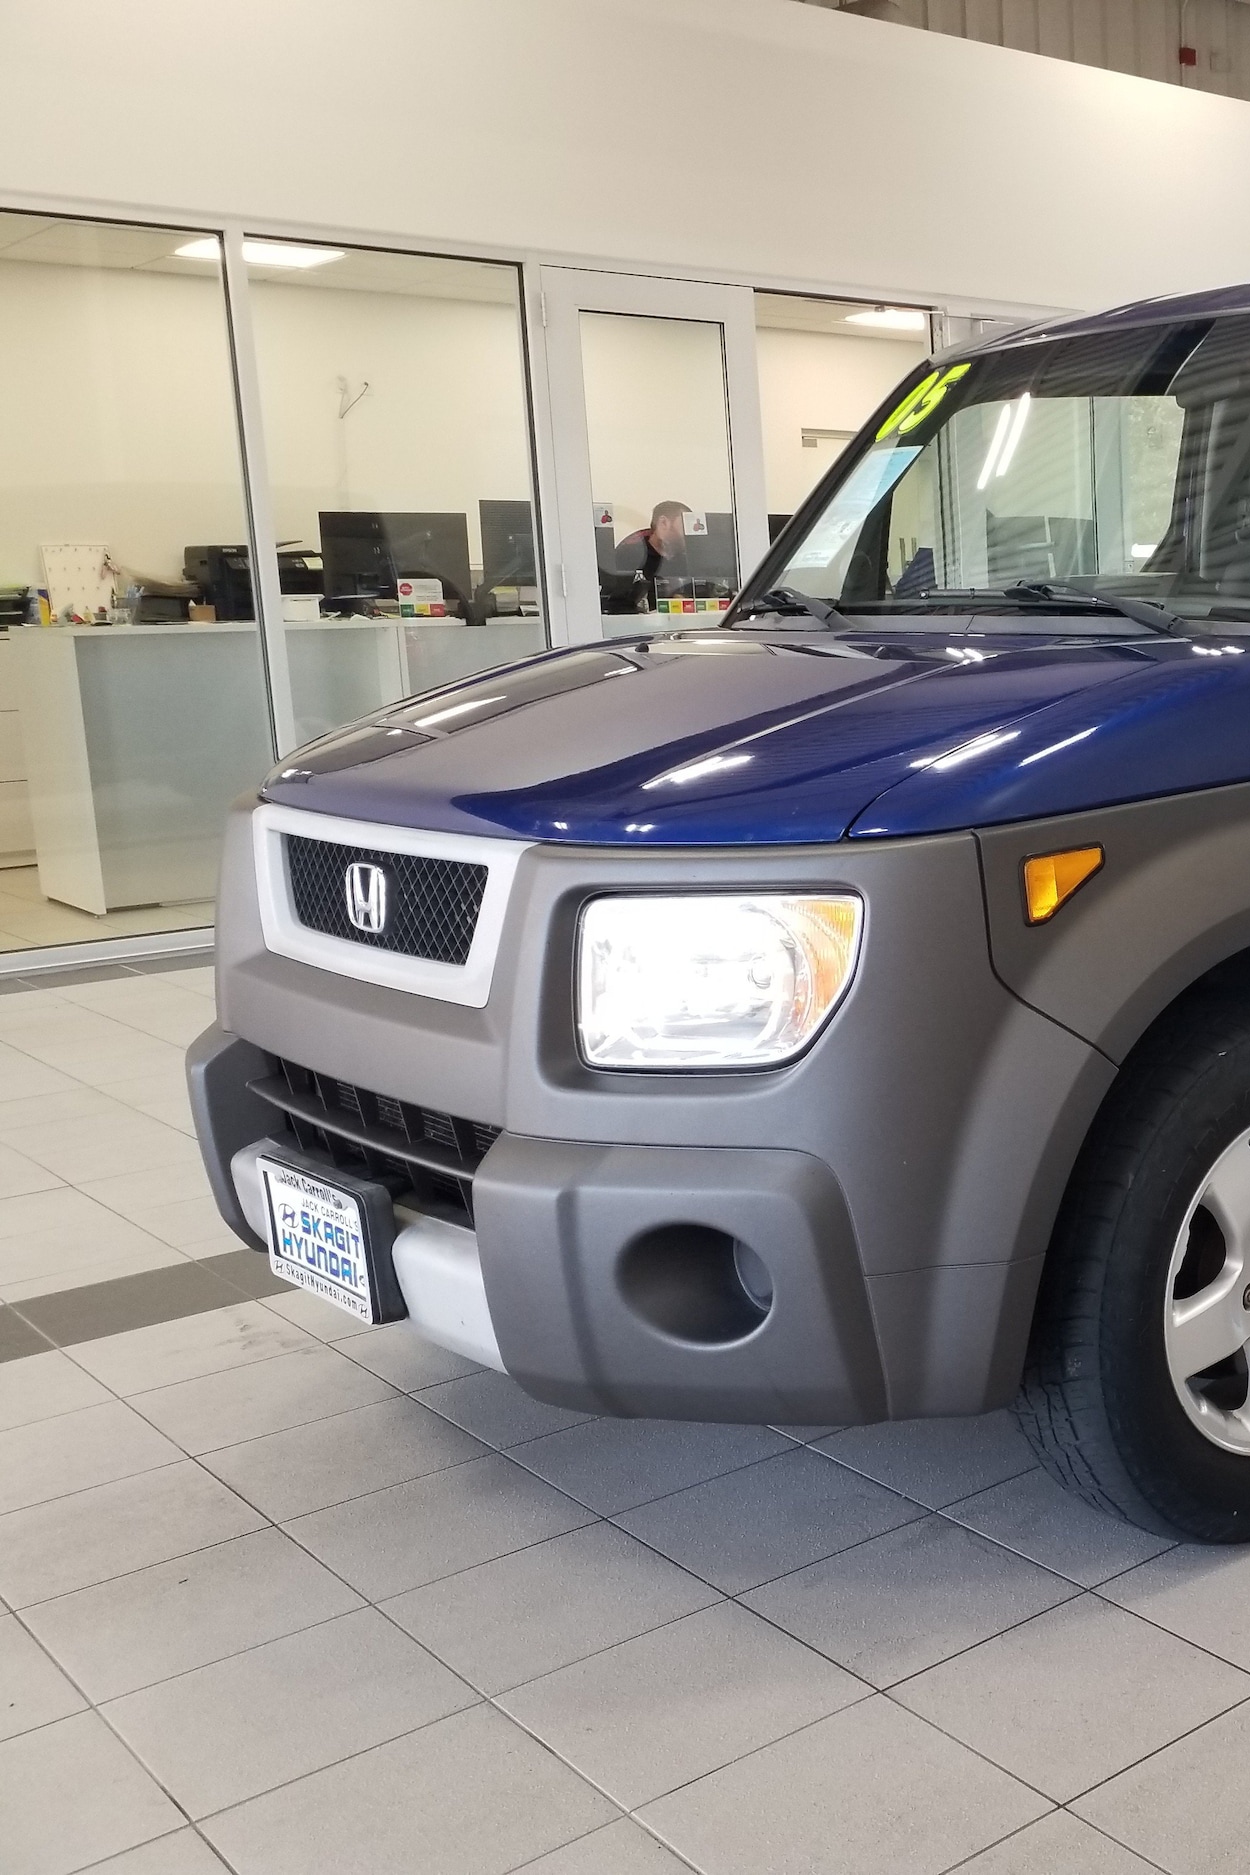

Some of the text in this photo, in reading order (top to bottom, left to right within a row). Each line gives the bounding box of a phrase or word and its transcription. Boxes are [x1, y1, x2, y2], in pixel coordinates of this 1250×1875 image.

[280, 1169, 301, 1191] Jack
[300, 1210, 360, 1260] SKAGIT
[301, 1197, 359, 1231] JACK CARROLLS
[281, 1228, 359, 1288] HYUNDAI
[285, 1263, 358, 1311] SkagitHyundai.com
